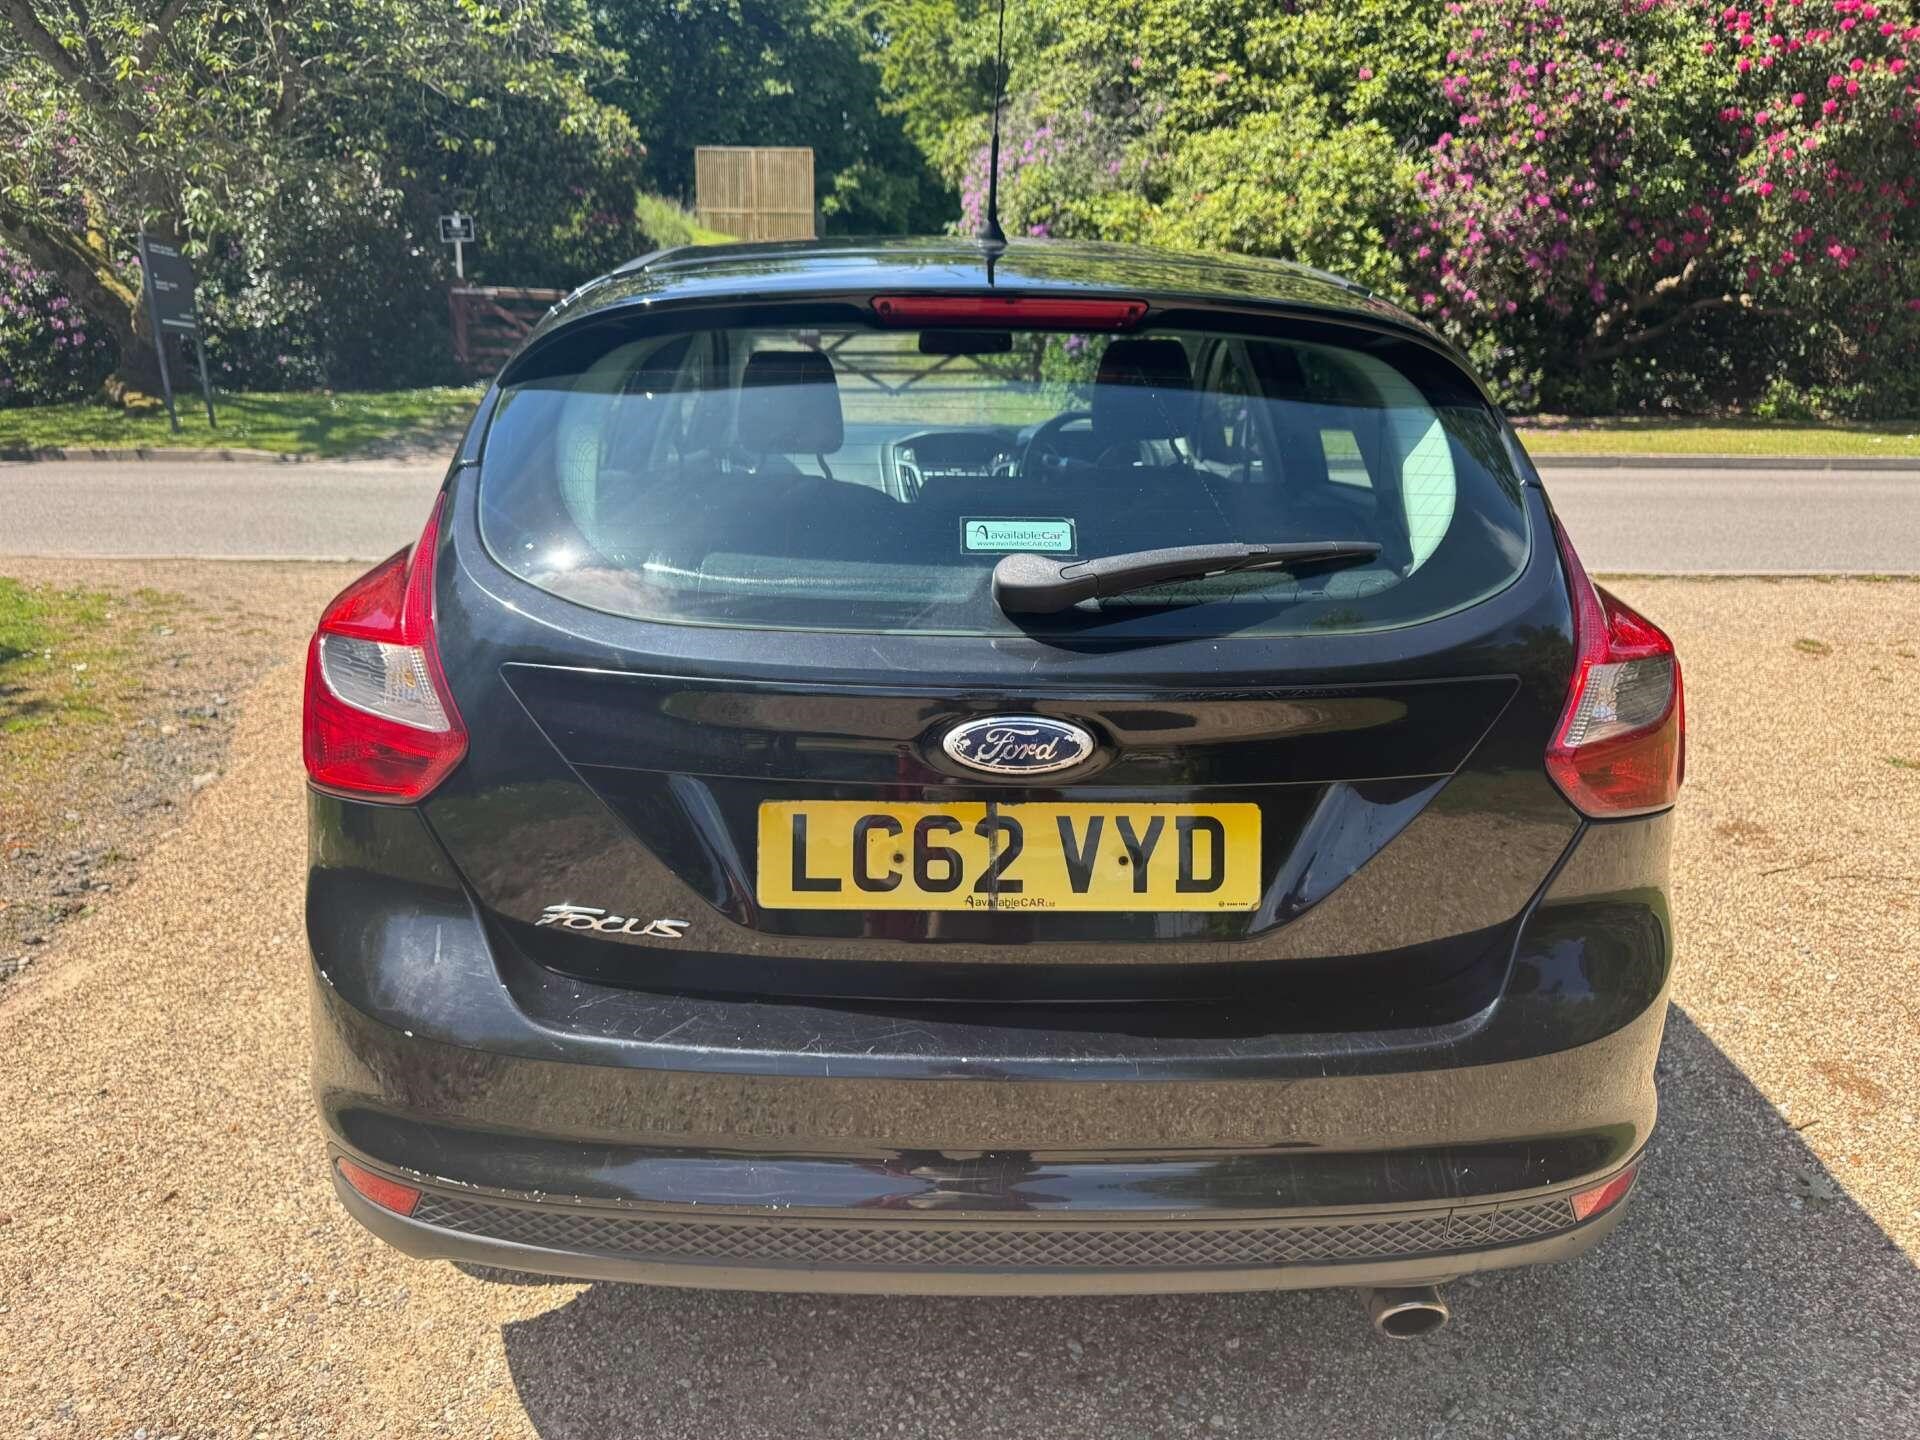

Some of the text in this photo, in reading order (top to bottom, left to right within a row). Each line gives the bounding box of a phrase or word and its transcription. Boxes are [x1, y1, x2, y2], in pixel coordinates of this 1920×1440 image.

[973, 727, 1059, 766] Ford
[791, 814, 1225, 894] LC62 VYD
